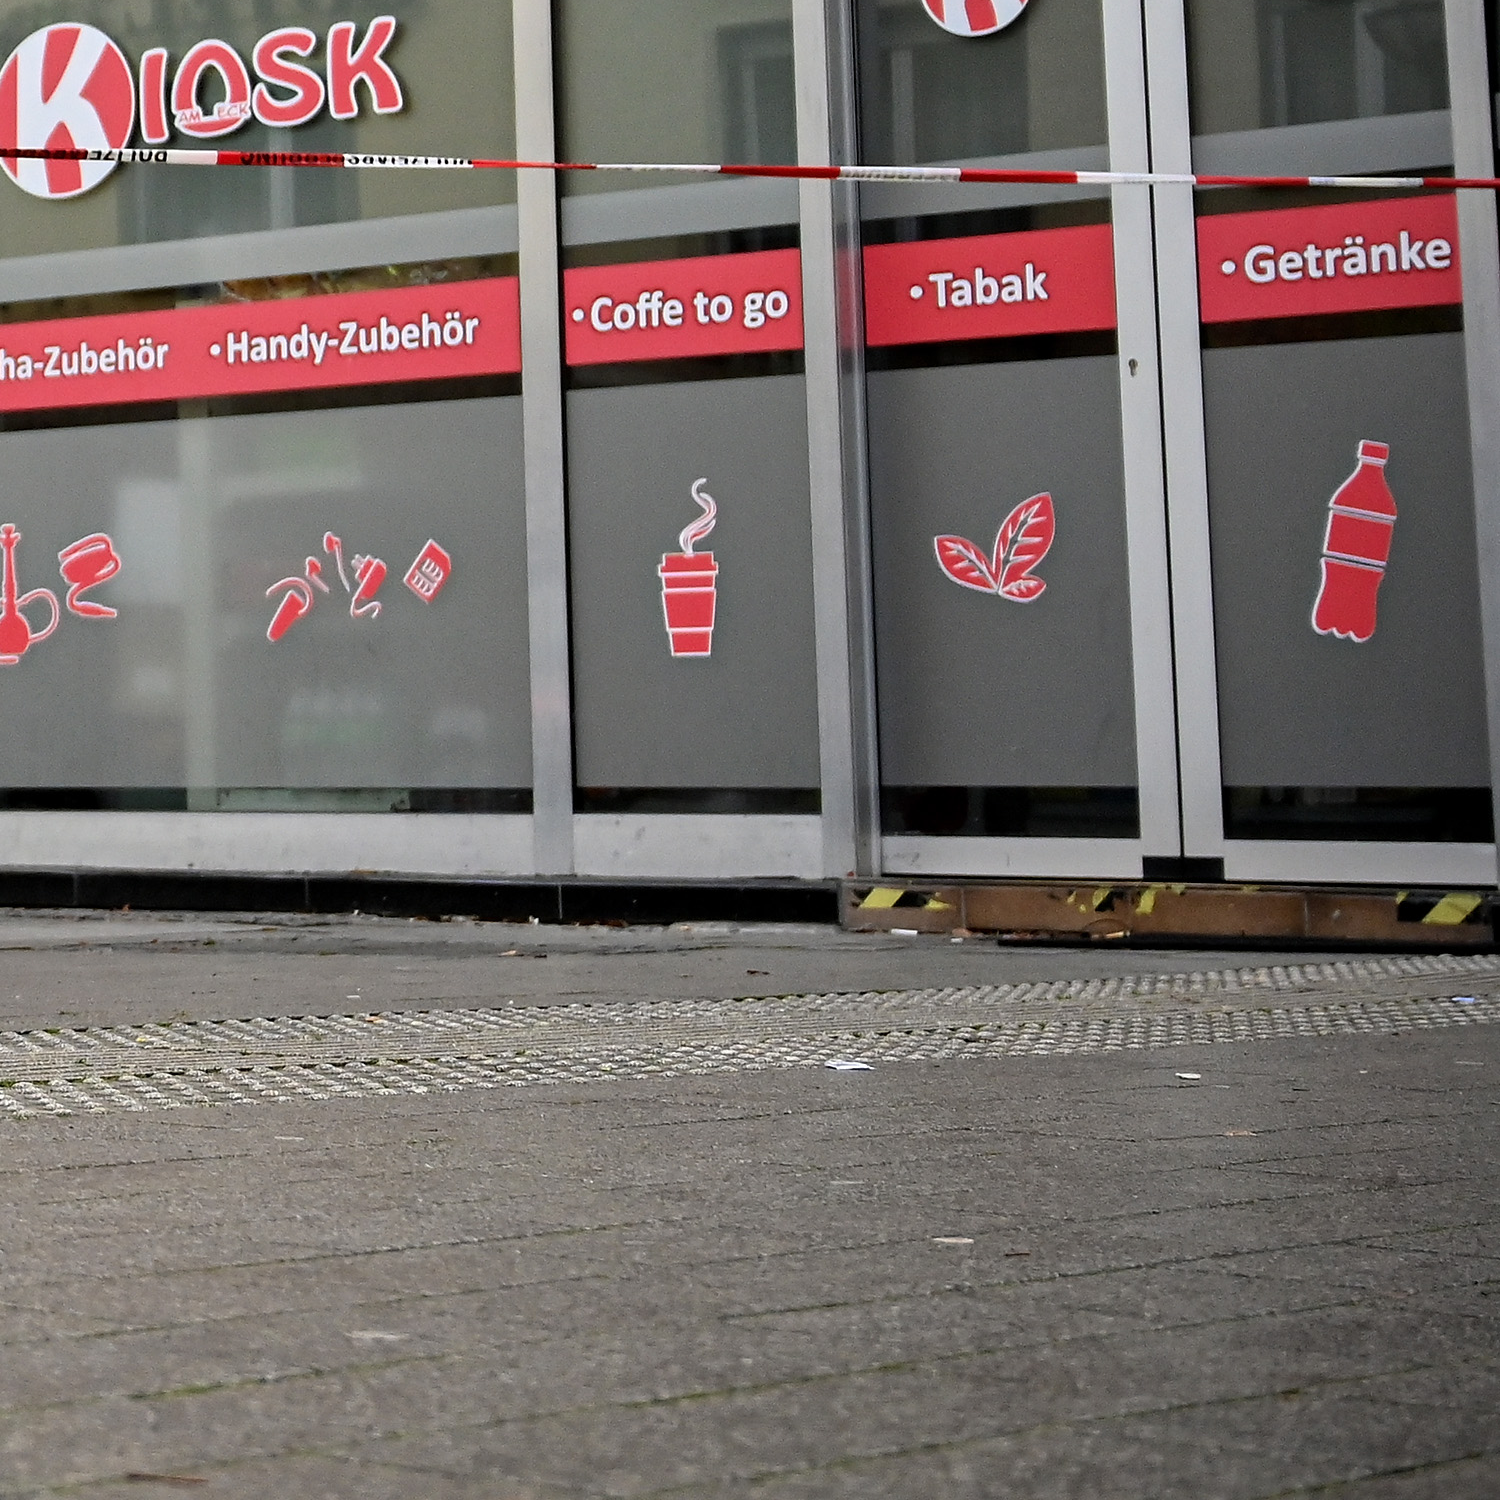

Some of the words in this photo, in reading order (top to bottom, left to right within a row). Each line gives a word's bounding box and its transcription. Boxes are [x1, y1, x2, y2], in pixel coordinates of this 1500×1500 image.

[1243, 230, 1452, 285] Getränke
[927, 262, 1049, 308] Tabak
[589, 290, 684, 332] Coffe
[693, 291, 734, 324] to
[743, 289, 789, 329] go
[226, 310, 480, 366] Handy-Zubehör
